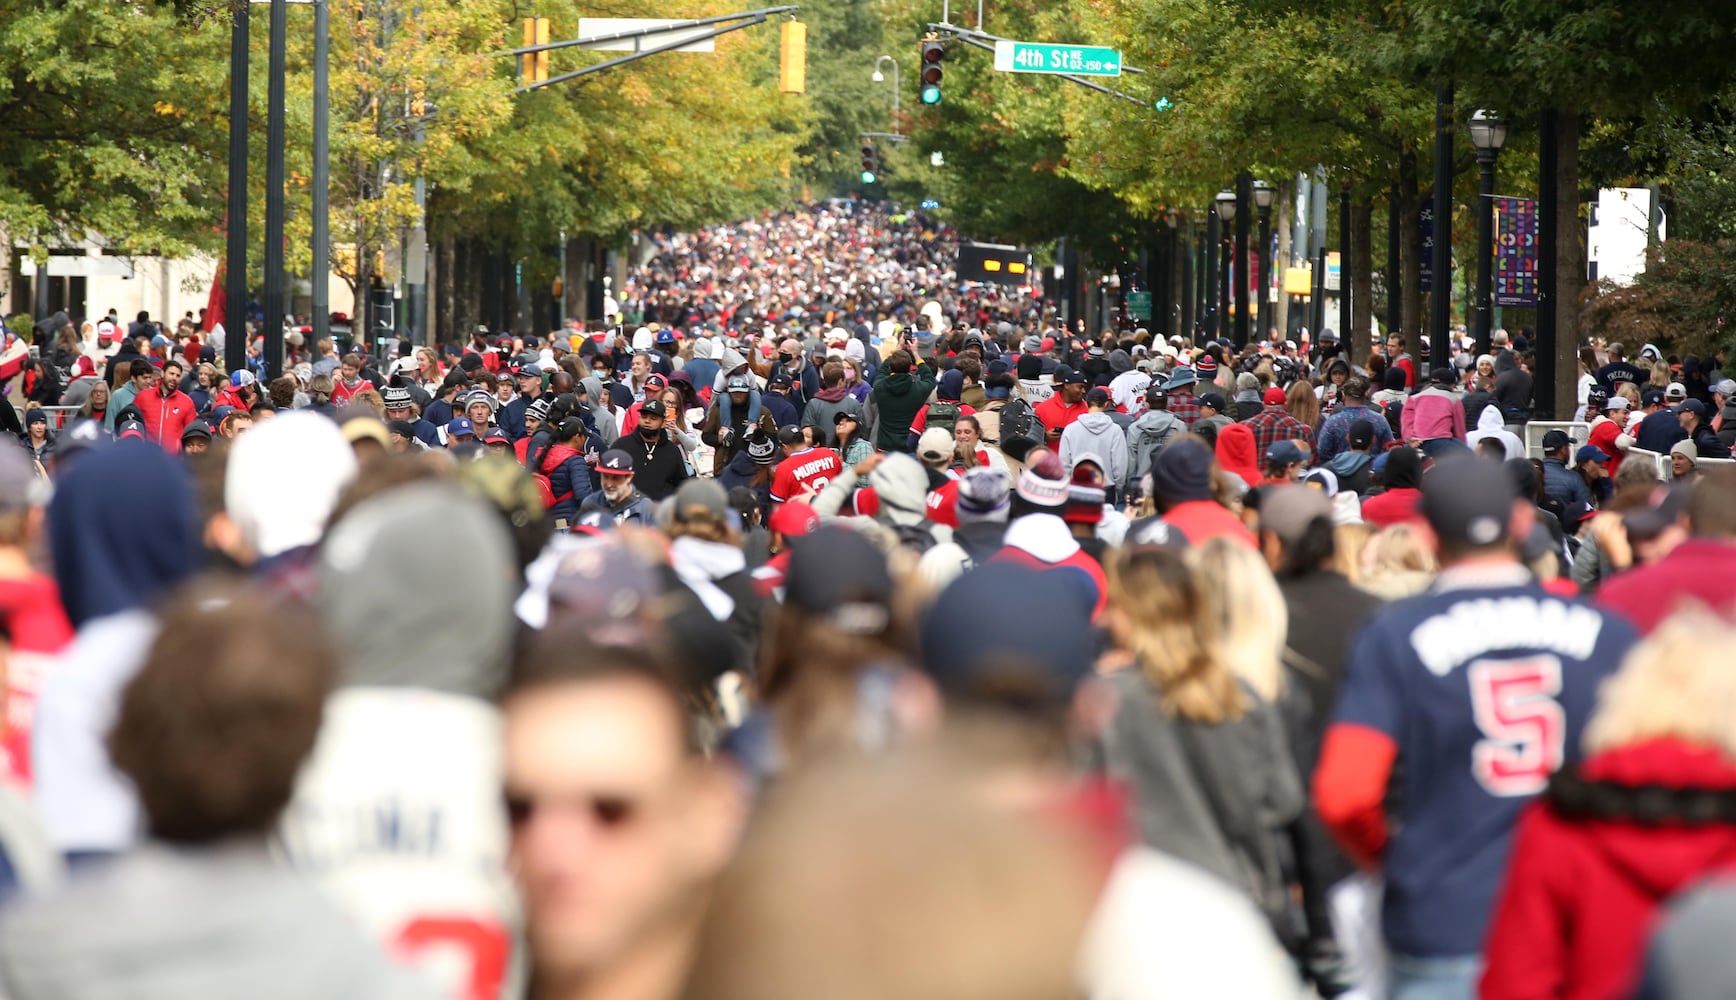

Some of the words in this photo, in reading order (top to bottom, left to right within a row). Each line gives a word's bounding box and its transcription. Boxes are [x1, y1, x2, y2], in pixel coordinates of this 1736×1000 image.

[1015, 48, 1044, 67] 4th
[1050, 49, 1069, 68] St
[1070, 50, 1083, 60] NE
[1607, 370, 1634, 381] FREEMAN
[792, 456, 835, 481] MURPHY
[1465, 653, 1567, 798] 5
